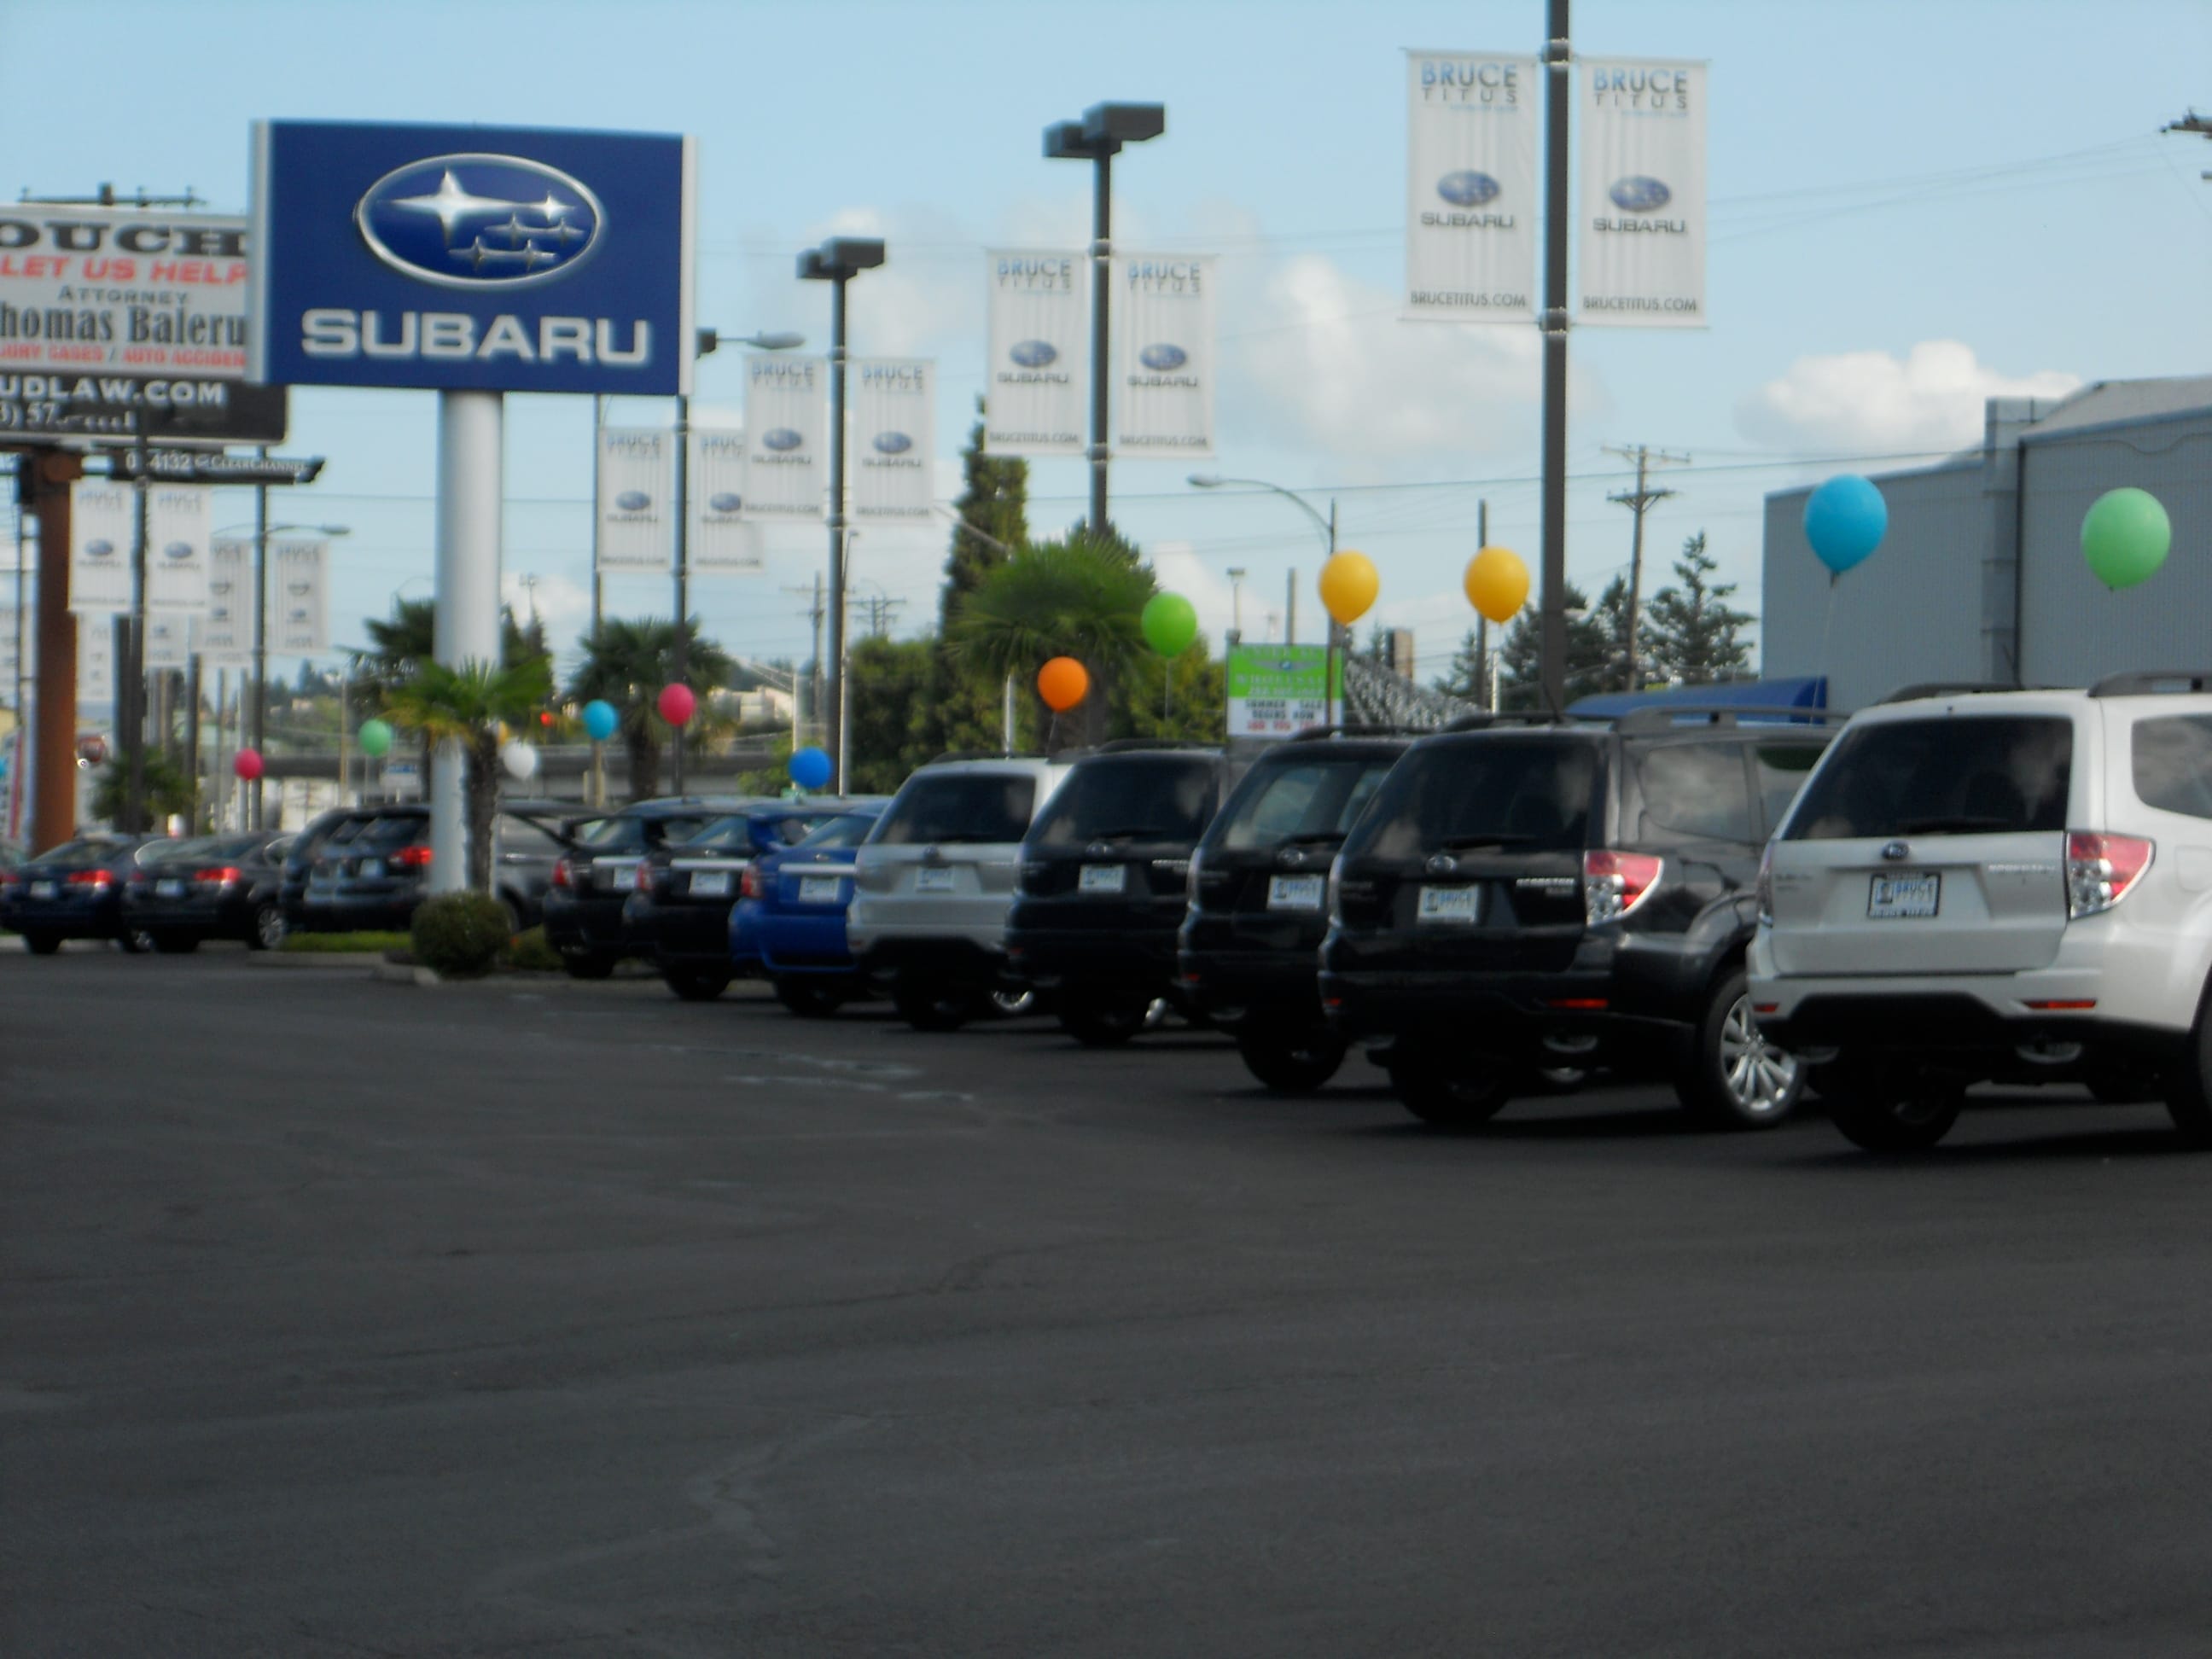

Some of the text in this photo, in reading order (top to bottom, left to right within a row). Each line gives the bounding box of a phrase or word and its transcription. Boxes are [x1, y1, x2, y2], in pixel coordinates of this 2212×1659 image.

[1421, 61, 1516, 87] BRUCE
[1593, 67, 1687, 93] BRUCE
[1421, 87, 1516, 103] TITUS
[1593, 93, 1687, 109] TITUS
[1421, 212, 1514, 229] SUBARU
[1592, 218, 1686, 234] SUBARU
[0, 219, 247, 257] OUCH
[0, 254, 247, 285] LET US HELP
[997, 259, 1071, 277] BRUCE
[1127, 262, 1201, 280] BRUCE
[57, 284, 189, 305] ATTORNEY
[1411, 290, 1527, 308] BRUCETITUS.COM
[1582, 295, 1697, 311] BRUCETITUS.COM
[301, 308, 650, 364] SUBARU
[123, 346, 165, 364] AUTO
[752, 361, 813, 376] BRUCE
[0, 375, 224, 407] UDLAW.COM
